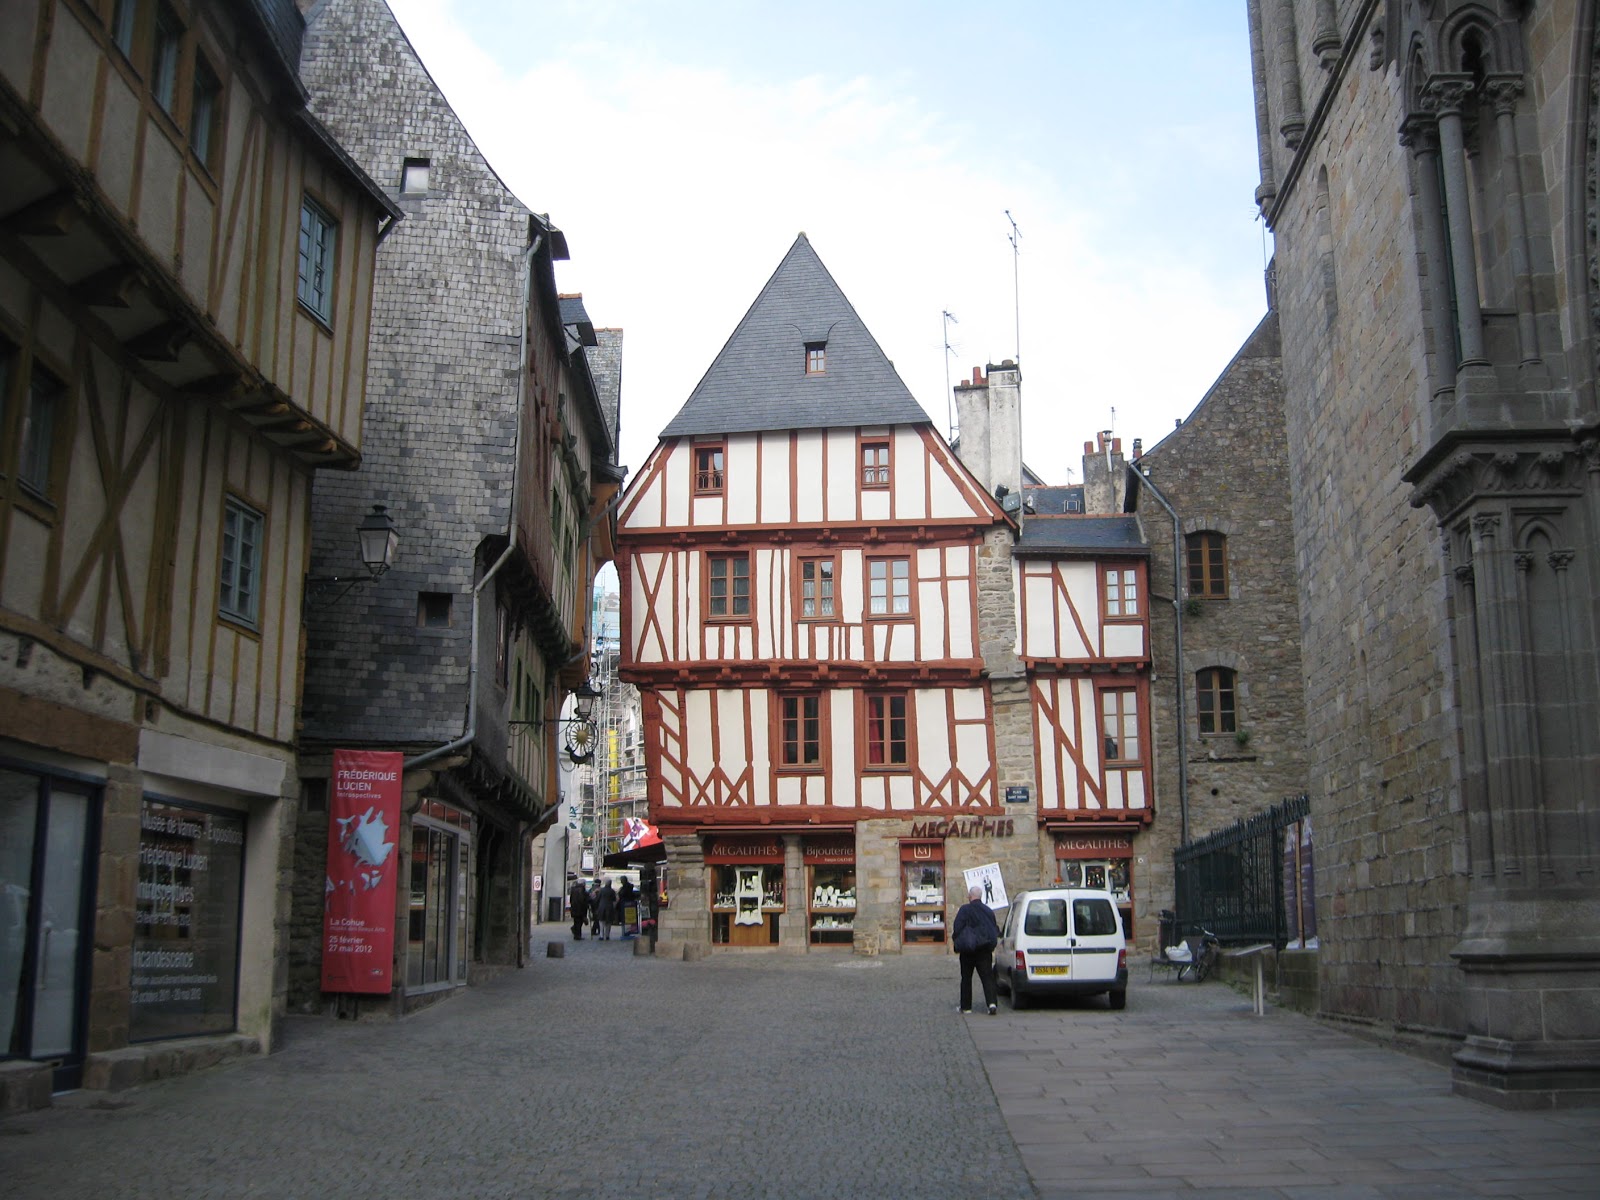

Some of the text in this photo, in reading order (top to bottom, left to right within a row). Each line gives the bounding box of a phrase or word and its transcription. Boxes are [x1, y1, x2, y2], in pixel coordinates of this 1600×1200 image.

[337, 769, 397, 781] FRÉDÉRIQUE
[337, 781, 372, 791] LUCIEN
[141, 811, 165, 832] Musée
[167, 817, 177, 834] de
[208, 821, 243, 845] Expositions
[911, 819, 1014, 838] MEGALITHES
[711, 844, 778, 856] MEGALITHES
[1058, 838, 1130, 850] MEGALITHES
[140, 842, 208, 870] Frédérique Lucien
[806, 845, 854, 858] Bijouterie
[330, 918, 365, 926] La Cohue
[329, 935, 364, 944] 25 février
[328, 944, 338, 952] 27
[355, 945, 373, 953] 2012
